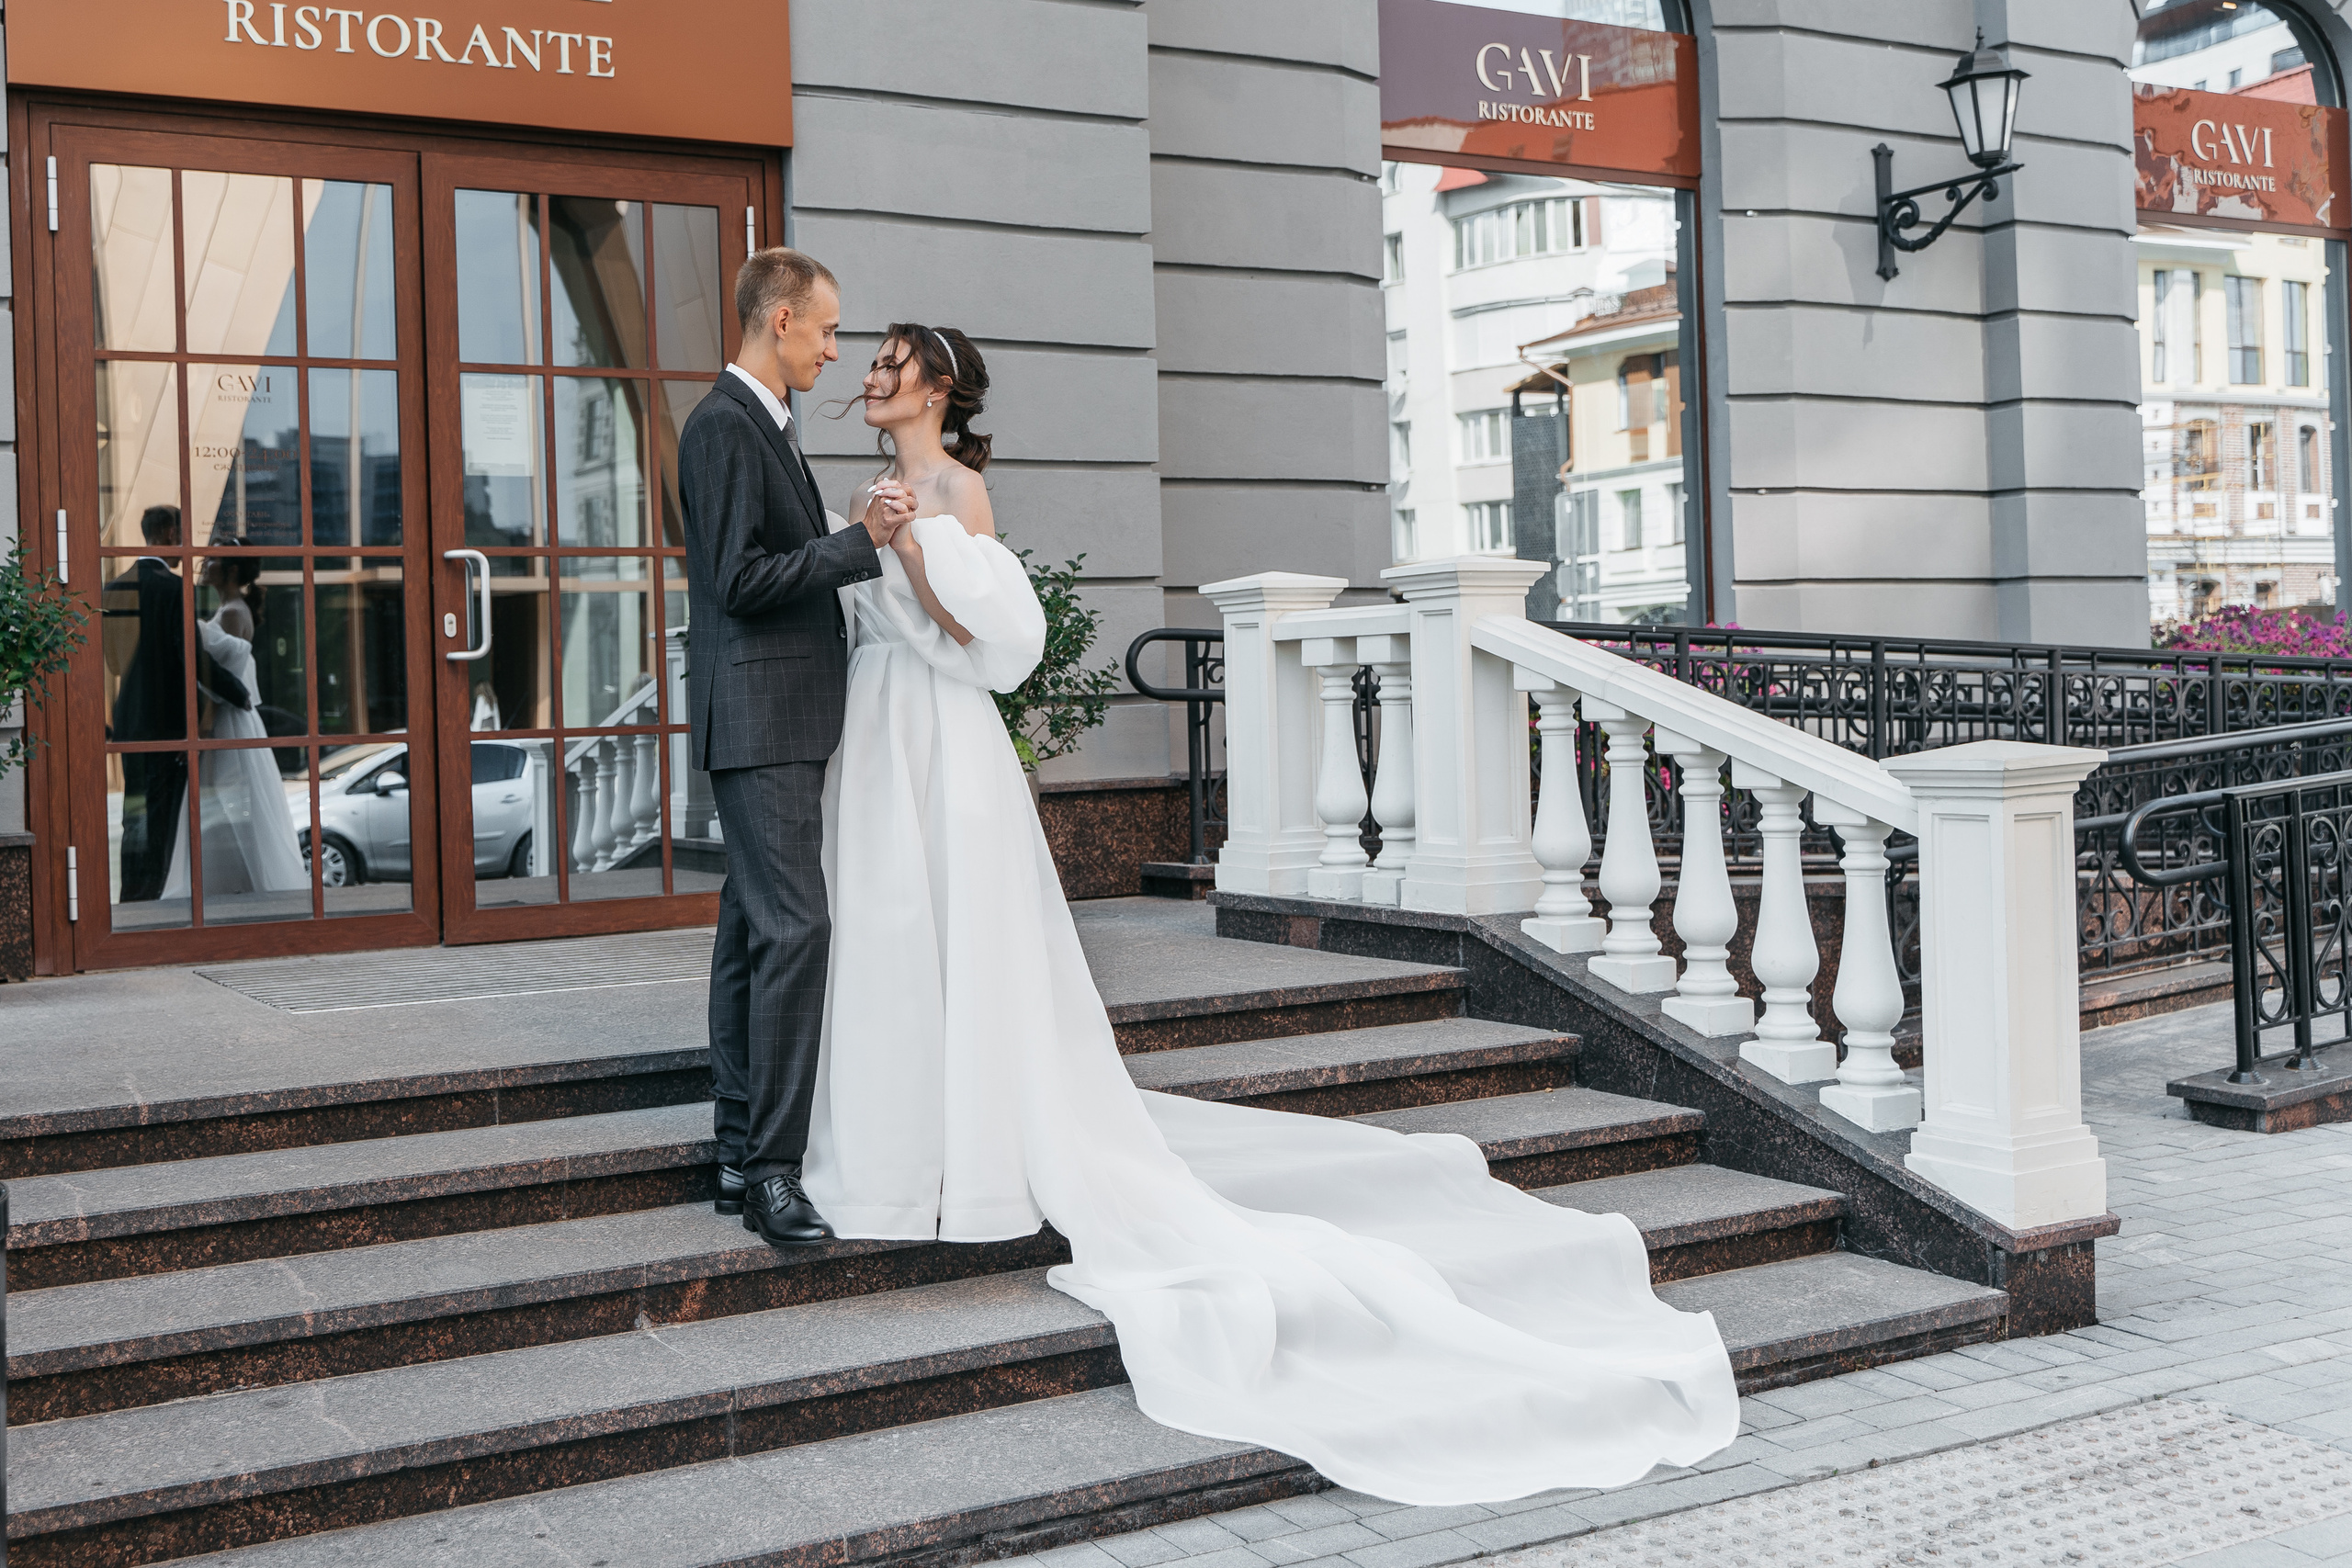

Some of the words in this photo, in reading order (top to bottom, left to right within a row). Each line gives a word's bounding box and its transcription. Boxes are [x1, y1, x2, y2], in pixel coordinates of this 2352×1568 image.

[223, 0, 616, 79] RISTORANTE
[1476, 42, 1593, 102] GAVI
[1477, 100, 1595, 130] RISTORANTE
[2191, 118, 2274, 168] GAVI
[2193, 167, 2277, 192] RISTORANTE
[218, 373, 271, 393] GAVI
